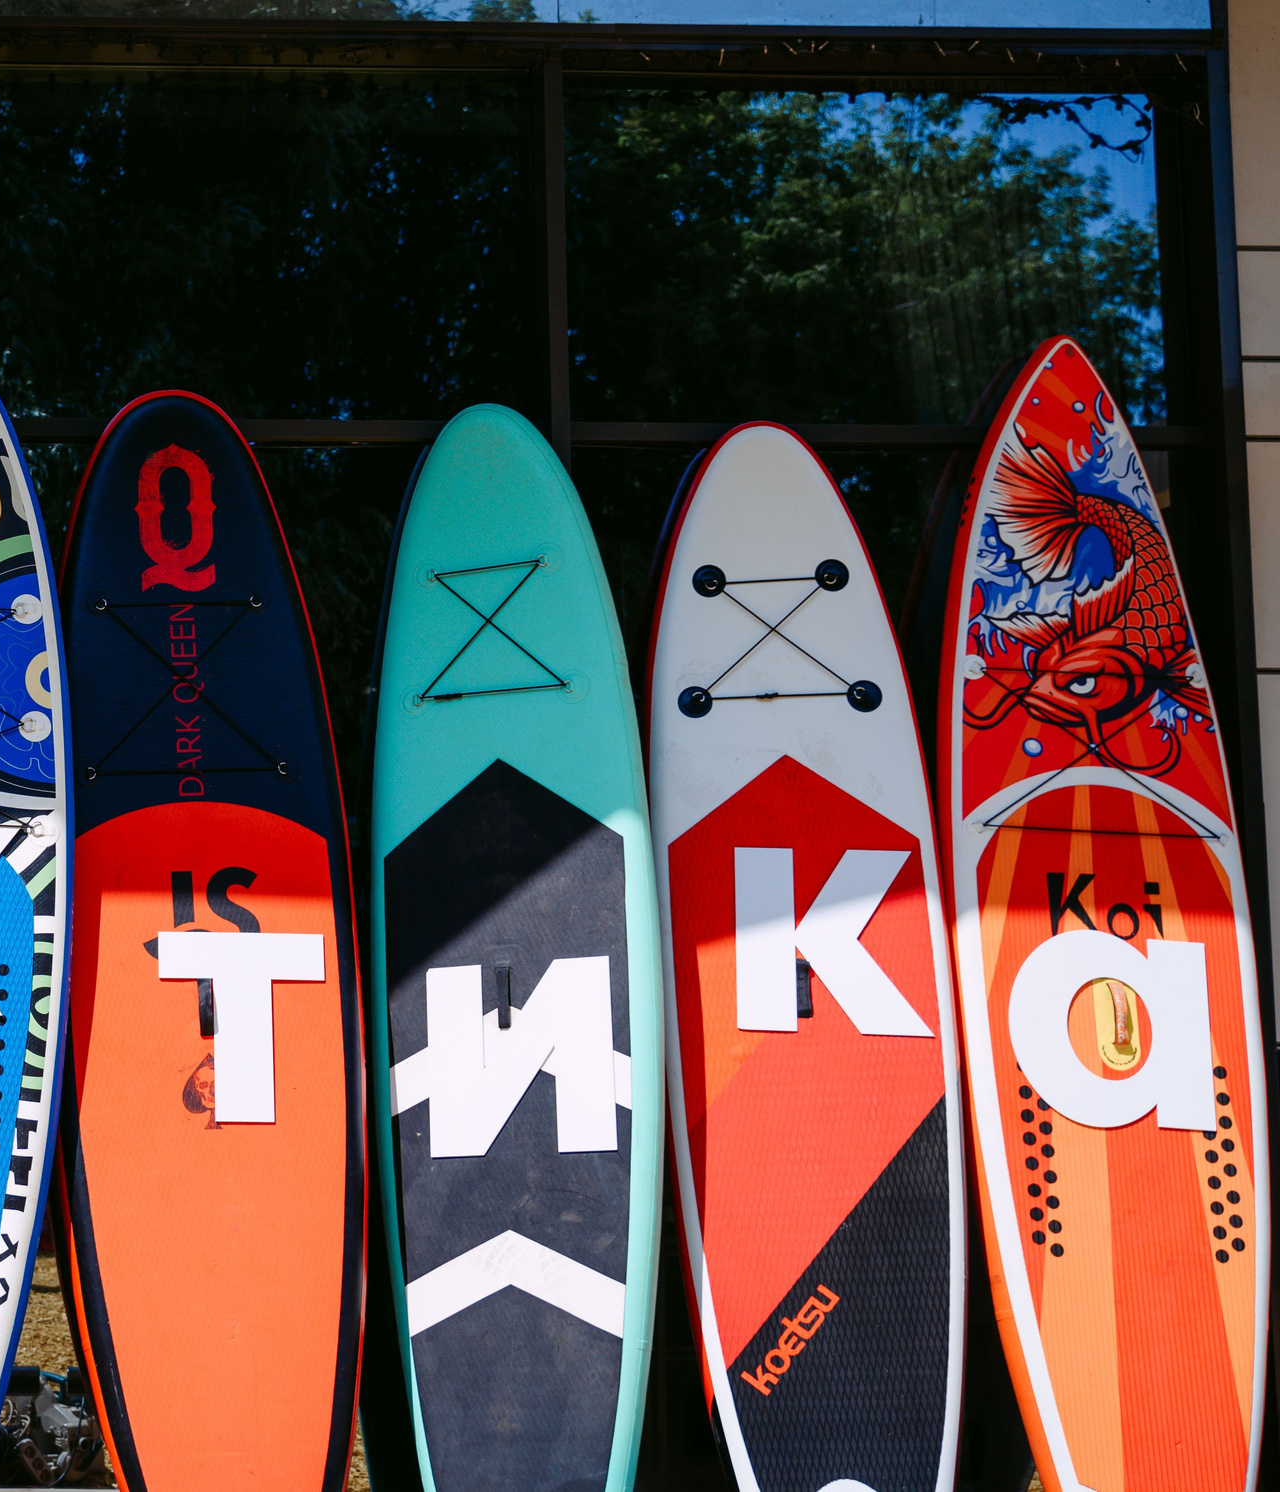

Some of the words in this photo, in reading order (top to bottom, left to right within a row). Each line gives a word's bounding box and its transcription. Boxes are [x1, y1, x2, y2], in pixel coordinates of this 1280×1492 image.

[134, 443, 217, 592] Q
[169, 603, 205, 704] QUEEN
[175, 714, 205, 797] DARK
[1046, 872, 1165, 940] Koi
[740, 1283, 841, 1397] koetsu
